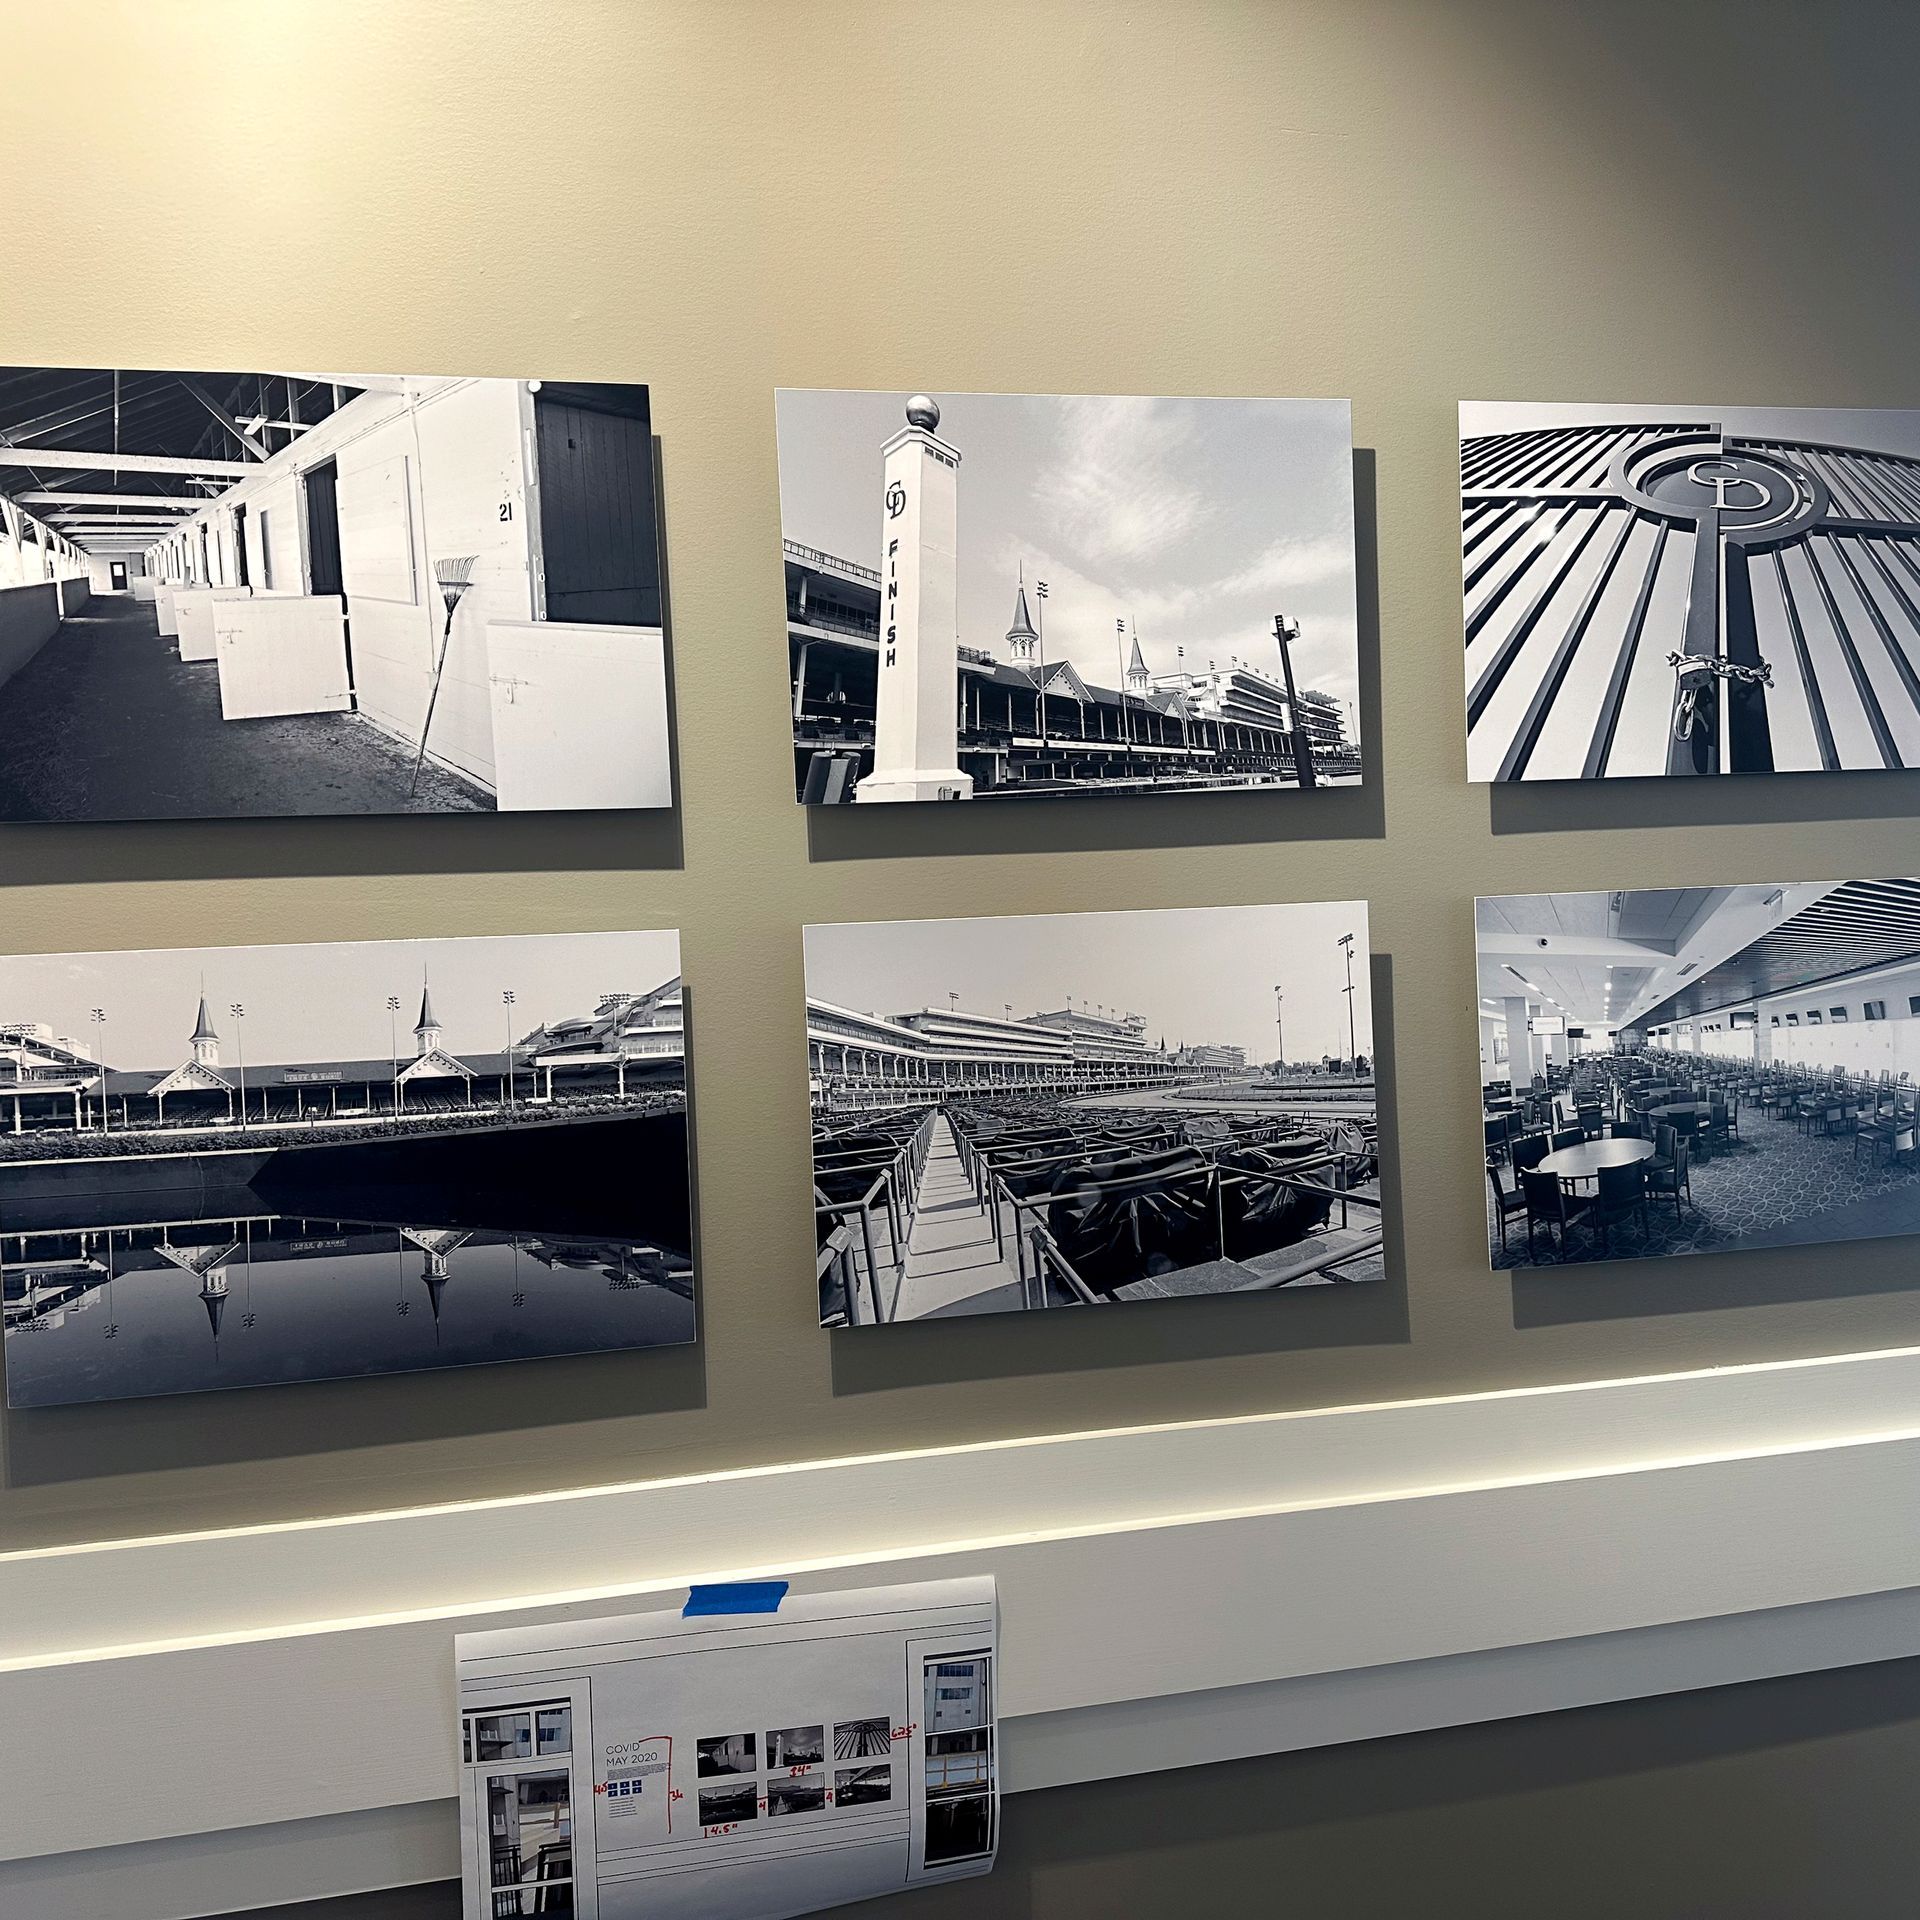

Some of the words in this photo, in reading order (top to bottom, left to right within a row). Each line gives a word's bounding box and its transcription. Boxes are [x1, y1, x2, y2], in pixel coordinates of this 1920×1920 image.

[499, 502, 512, 522] 21
[886, 538, 899, 667] FINISH
[605, 1742, 641, 1755] COVID
[606, 1756, 628, 1767] MAY
[631, 1751, 658, 1764] 2020
